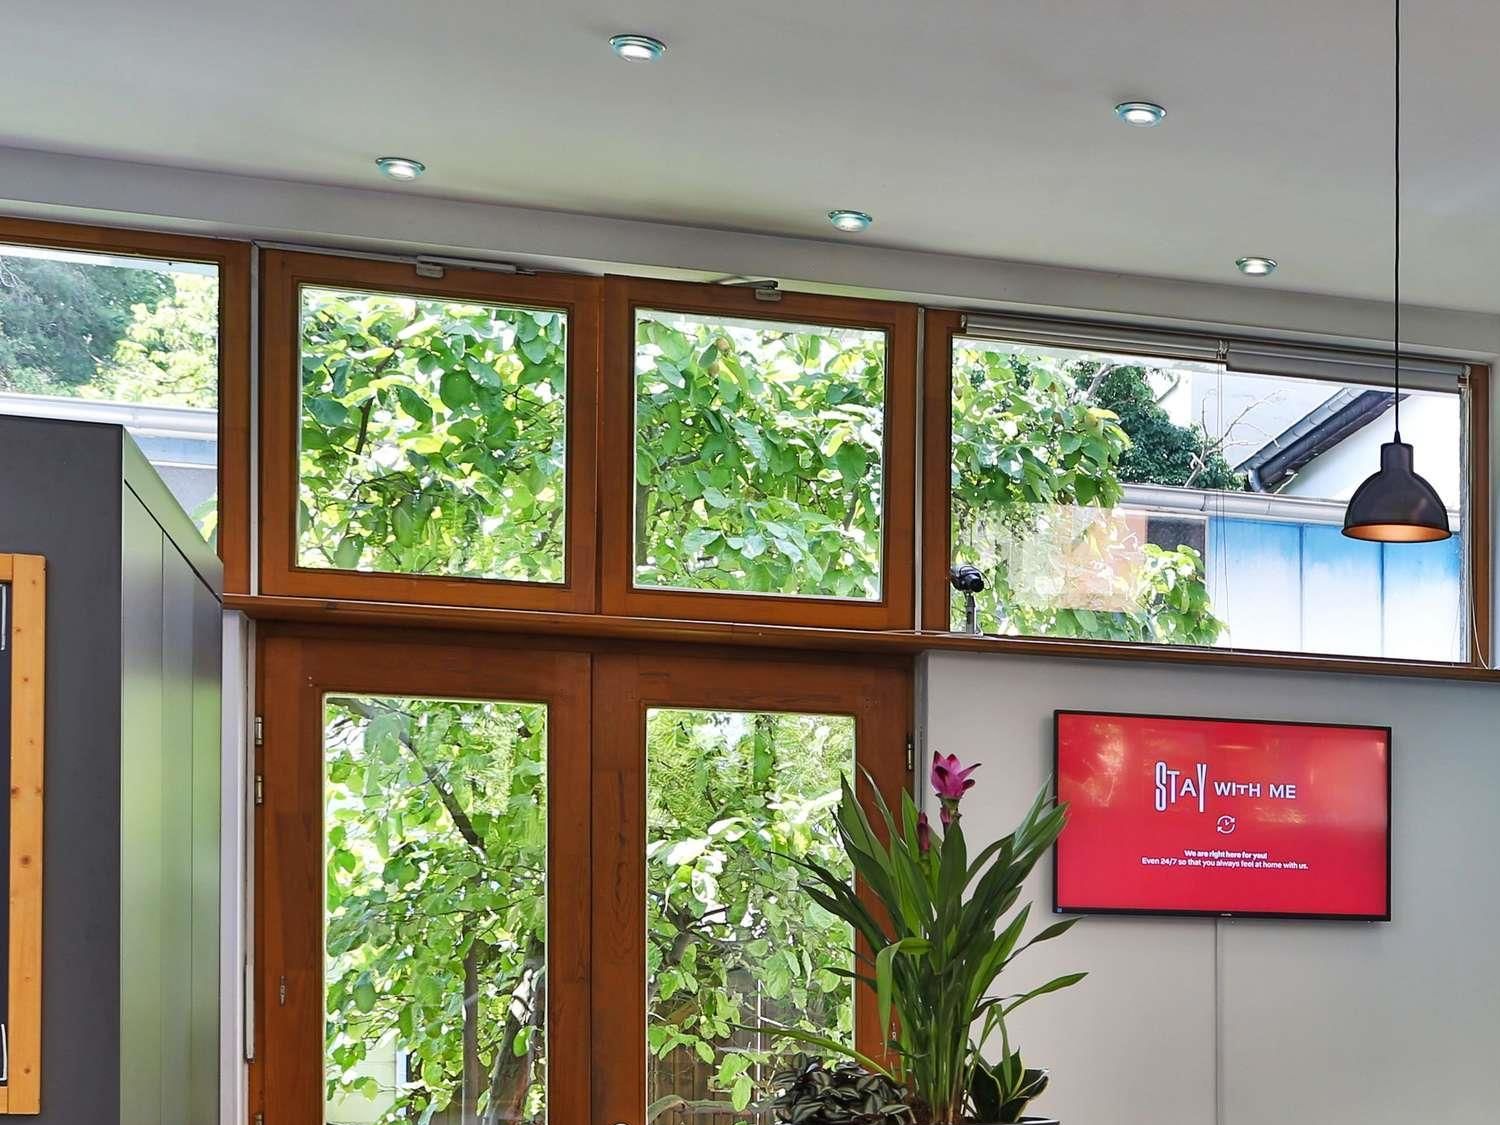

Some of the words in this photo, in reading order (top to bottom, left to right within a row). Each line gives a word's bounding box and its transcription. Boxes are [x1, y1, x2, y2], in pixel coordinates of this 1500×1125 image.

[1155, 761, 1207, 812] STAY
[1214, 781, 1261, 798] WITH
[1269, 784, 1296, 799] ME
[1209, 850, 1226, 859] right
[1141, 857, 1160, 865] Even
[1160, 857, 1178, 866] 24/7
[1202, 860, 1216, 868] you
[1216, 860, 1240, 868] always
[1241, 860, 1254, 868] feel
[1262, 861, 1282, 869] home
